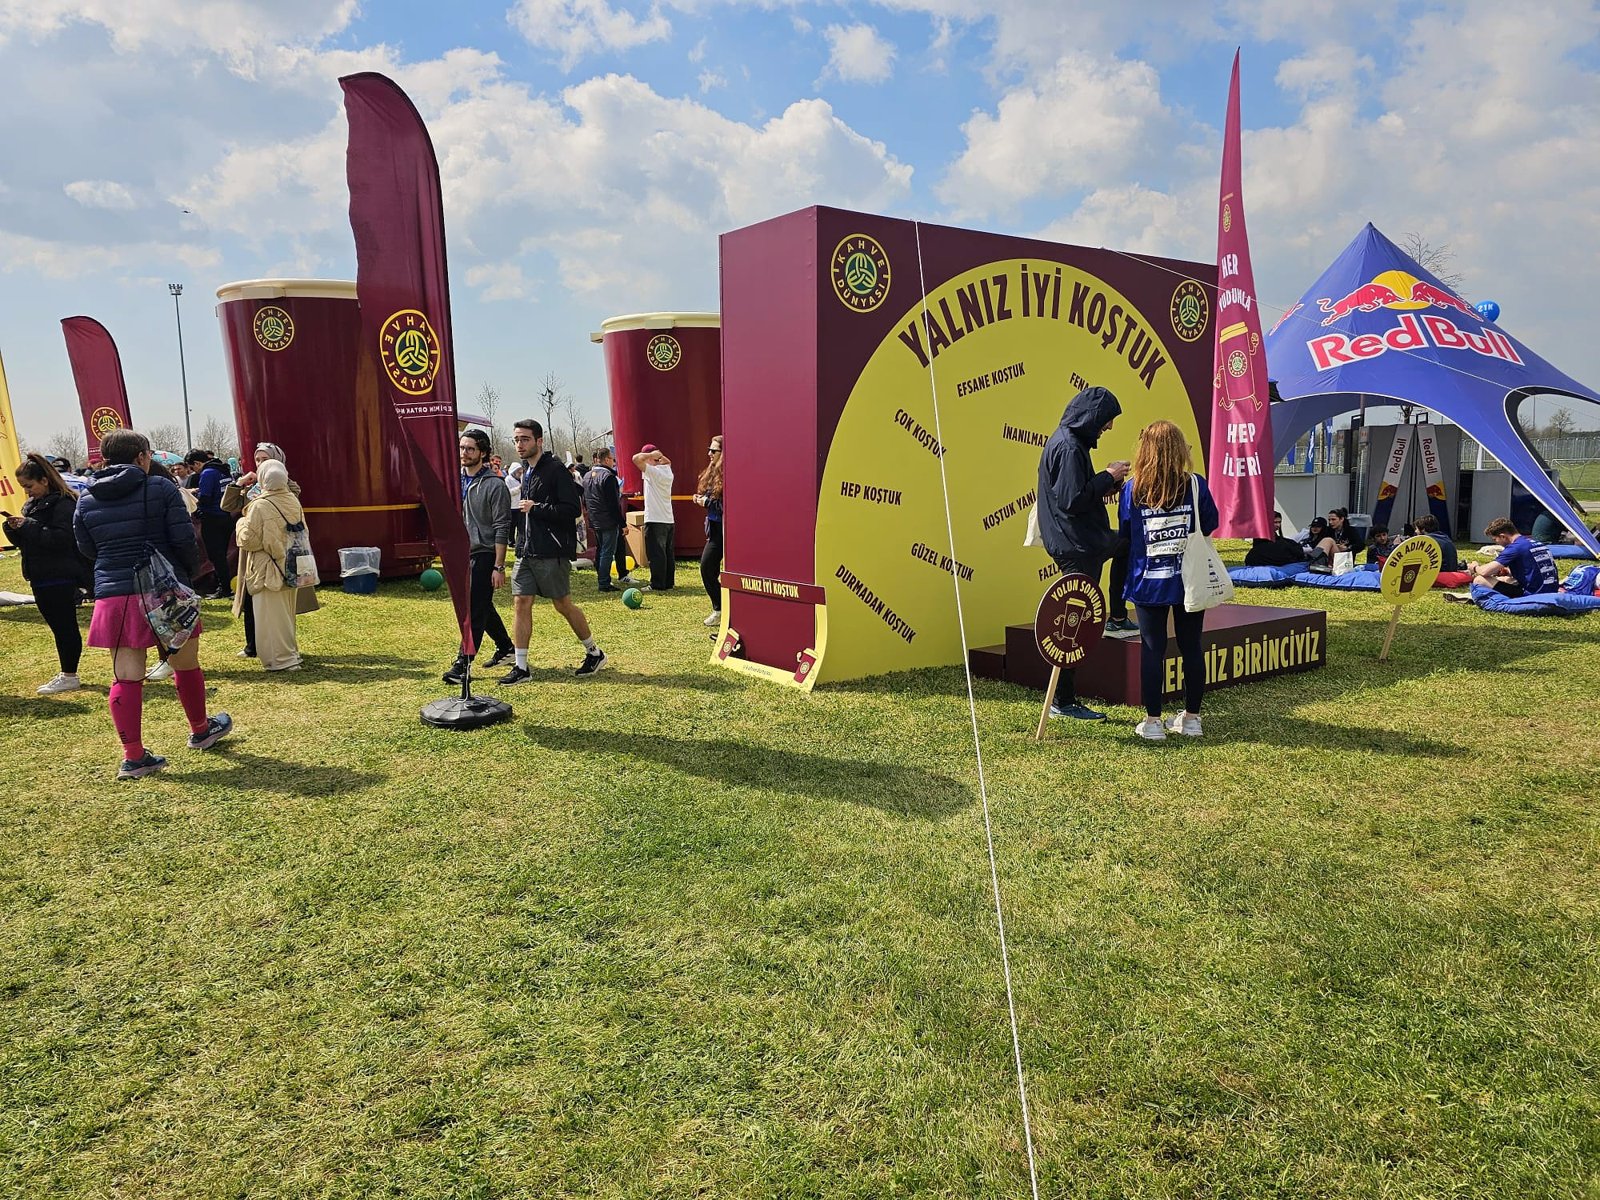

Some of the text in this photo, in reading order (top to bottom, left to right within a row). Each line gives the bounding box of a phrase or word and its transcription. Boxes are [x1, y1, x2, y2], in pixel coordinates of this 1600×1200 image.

[837, 239, 885, 307] KAHVE DÜNYASI
[1221, 253, 1239, 278] HER
[1174, 284, 1206, 338] KAHVE DÜNYASI
[1219, 287, 1251, 312] YUDUMLA
[256, 309, 289, 325] KAHVE
[897, 263, 1167, 391] YALNIZ İYİ KOŞTUK
[1306, 314, 1430, 372] Red
[1420, 314, 1526, 366] Bull
[956, 362, 1026, 398] EFSANE KOŞTUK
[894, 408, 947, 460] ÇOK KOŞTUK
[1003, 423, 1049, 448] İNANILMAZ
[1227, 422, 1256, 444] HEP
[1222, 452, 1262, 477] İLERİ
[840, 481, 902, 506] HEP KOŞTUK
[982, 488, 1037, 531] KOŞTUK YANİ
[911, 542, 974, 581] GÜZEL KOŞTUK
[1405, 540, 1426, 554] ADIM
[1424, 543, 1439, 570] DAHA!
[740, 577, 800, 598] YALNIZ İYİ KOŞTUK
[1050, 579, 1079, 602] YOLUN
[1079, 580, 1103, 624] SONUNDA
[834, 564, 916, 644] DURMADAN KOŞTUK
[1041, 635, 1065, 663] KAHVE
[1065, 646, 1086, 664] VAR!
[1232, 626, 1320, 679] BİRİNCİYİZ
